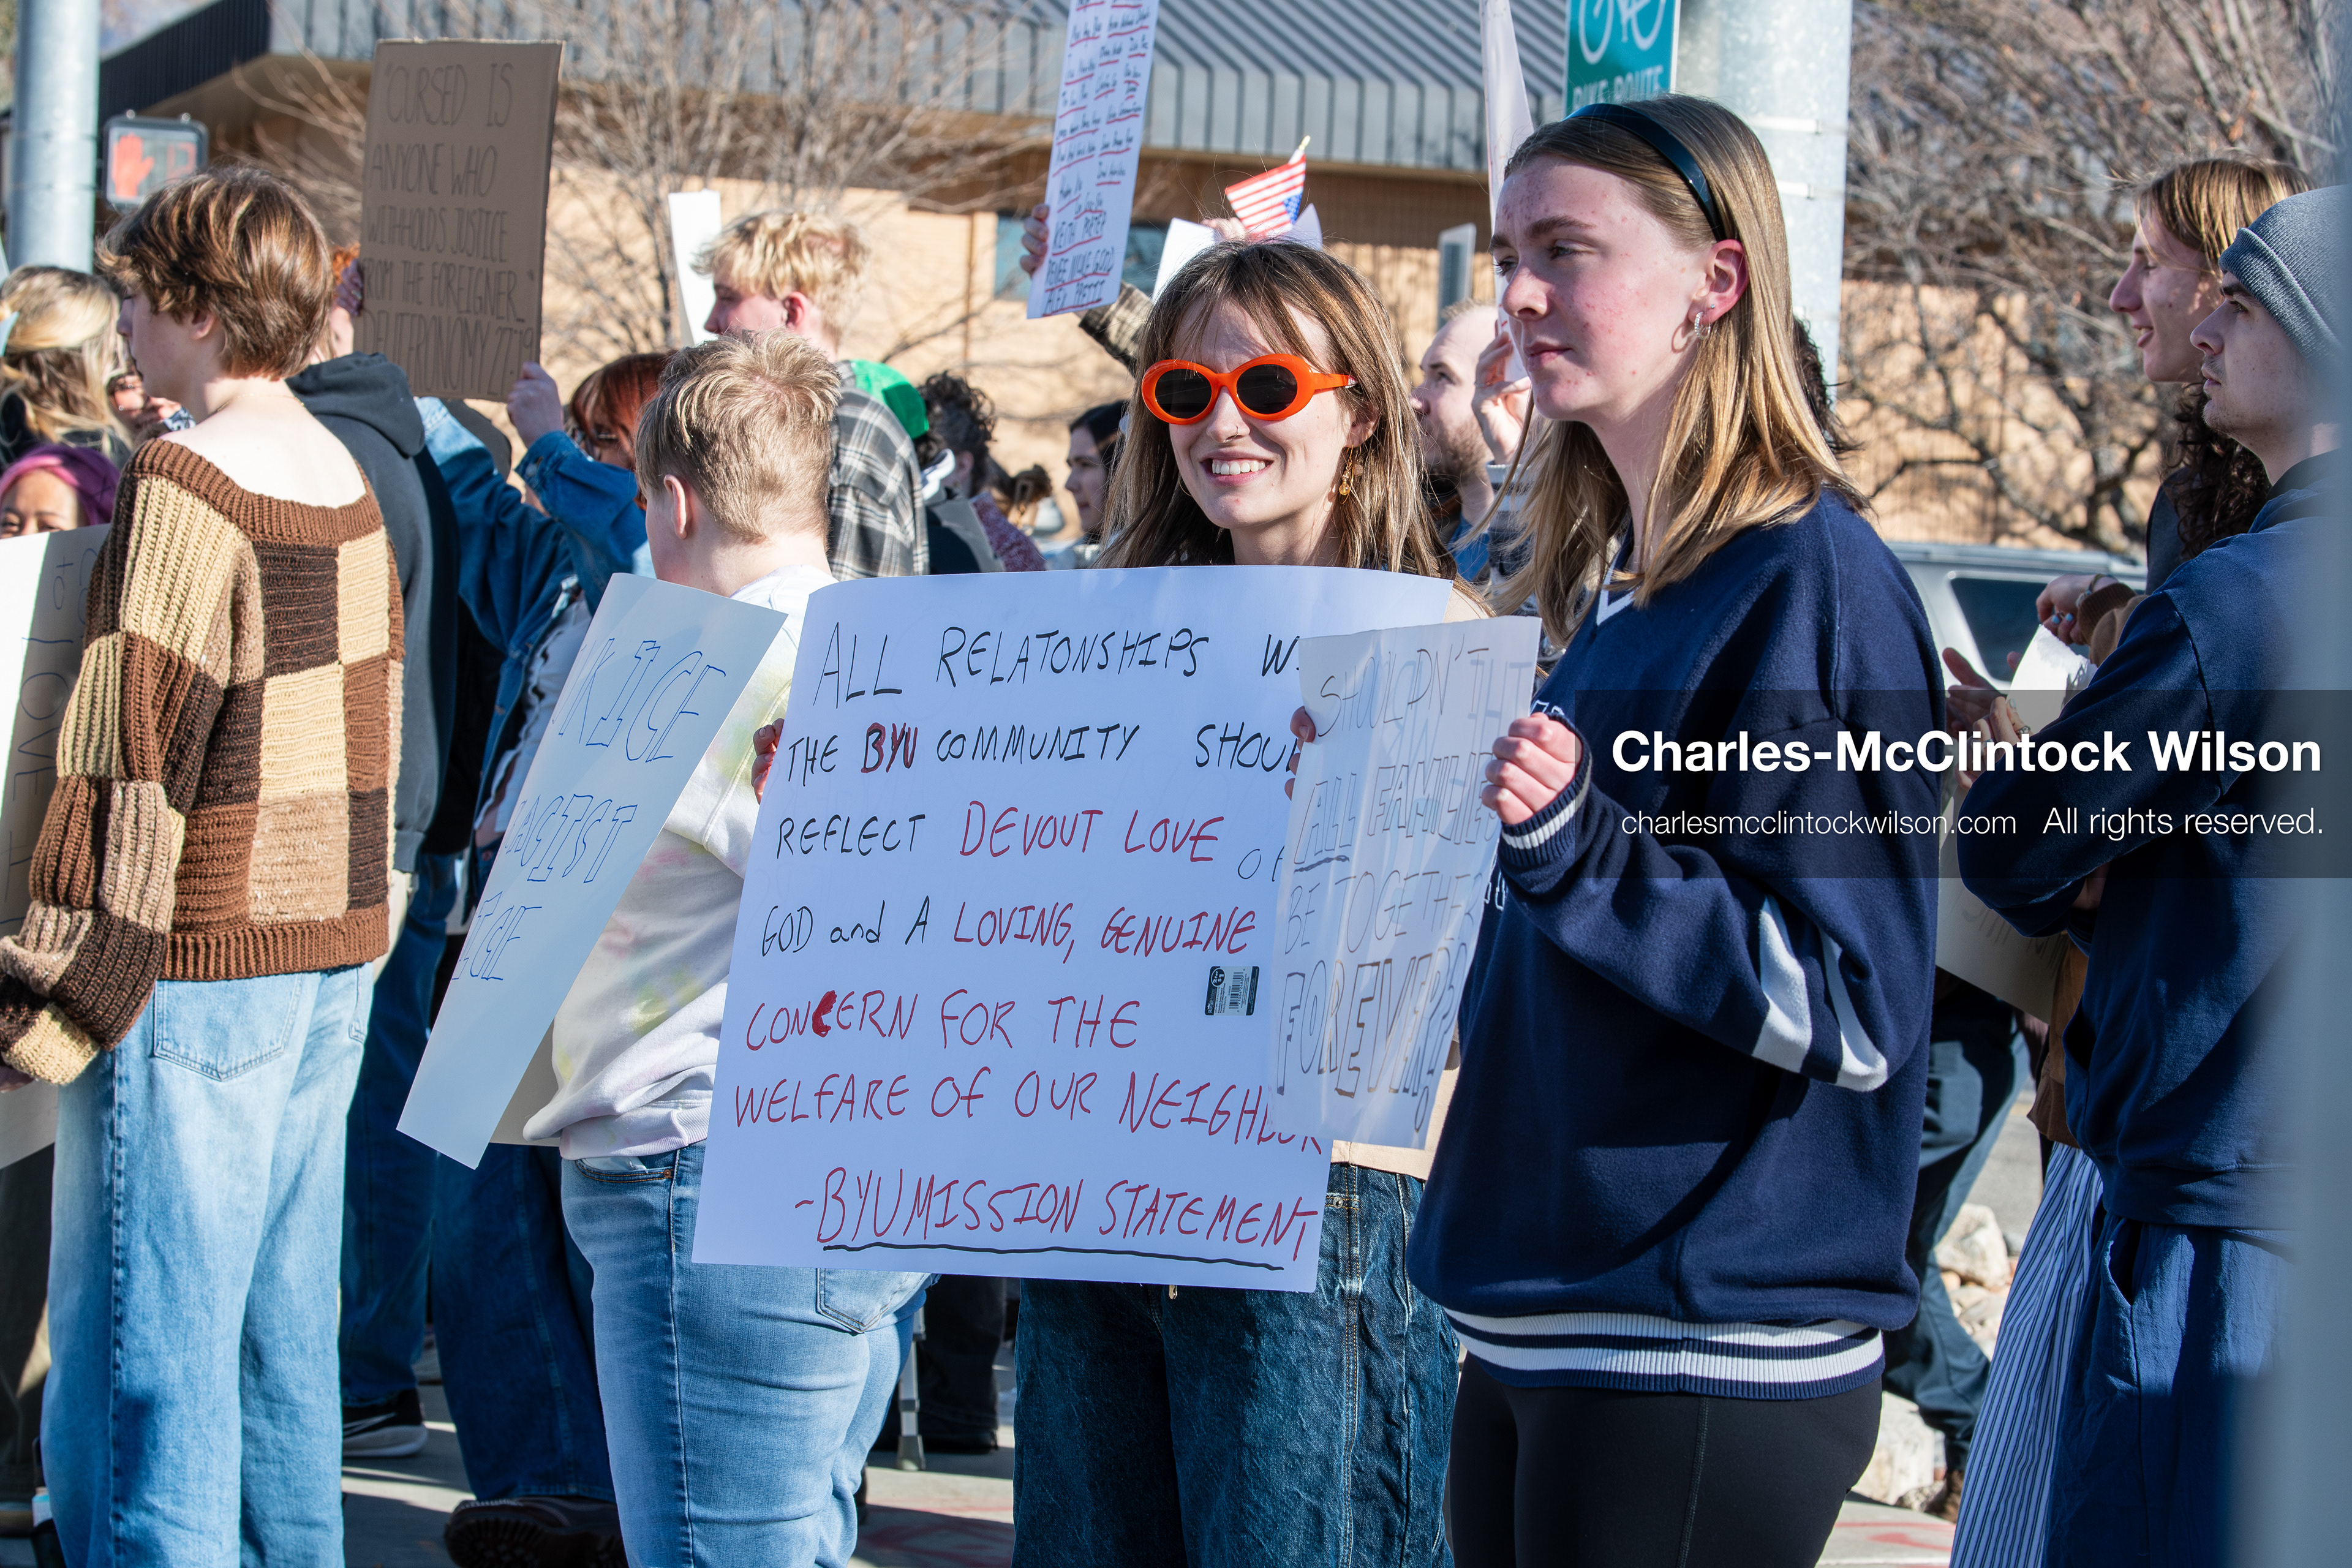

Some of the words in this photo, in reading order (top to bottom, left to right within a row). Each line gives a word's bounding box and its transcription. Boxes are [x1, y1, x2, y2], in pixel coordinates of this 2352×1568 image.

[486, 62, 514, 127] IS
[371, 143, 444, 195] ANYONE
[450, 145, 498, 197] WHO
[450, 207, 508, 263] JUSTICE
[400, 259, 425, 306] THE
[813, 622, 903, 709] ALL
[936, 627, 1209, 688] RELATONSHIPS
[1317, 633, 1489, 737] SHOULDN'T
[586, 641, 726, 763] ICE
[788, 734, 838, 787] THE
[861, 722, 918, 774] BYU
[937, 723, 1140, 765] COMMUNITY
[776, 815, 926, 859] REFLECT
[959, 801, 1103, 858] DEVOUT
[1125, 809, 1224, 862] LOVE
[1294, 772, 1357, 865] ALL
[761, 905, 813, 957] GOD
[830, 899, 886, 944] and
[905, 895, 930, 946] A
[953, 901, 1075, 964] LOVING,
[1101, 906, 1256, 957] GENUINE
[1284, 882, 1321, 955] BE
[1334, 870, 1483, 954] TOGETHER
[746, 990, 919, 1051] CONCERN
[941, 989, 1016, 1049] FOR
[1047, 994, 1140, 1049] THE
[736, 1073, 910, 1128] WELFARE
[1014, 1070, 1098, 1121] OUR
[1099, 1180, 1318, 1262] STATEMENT
